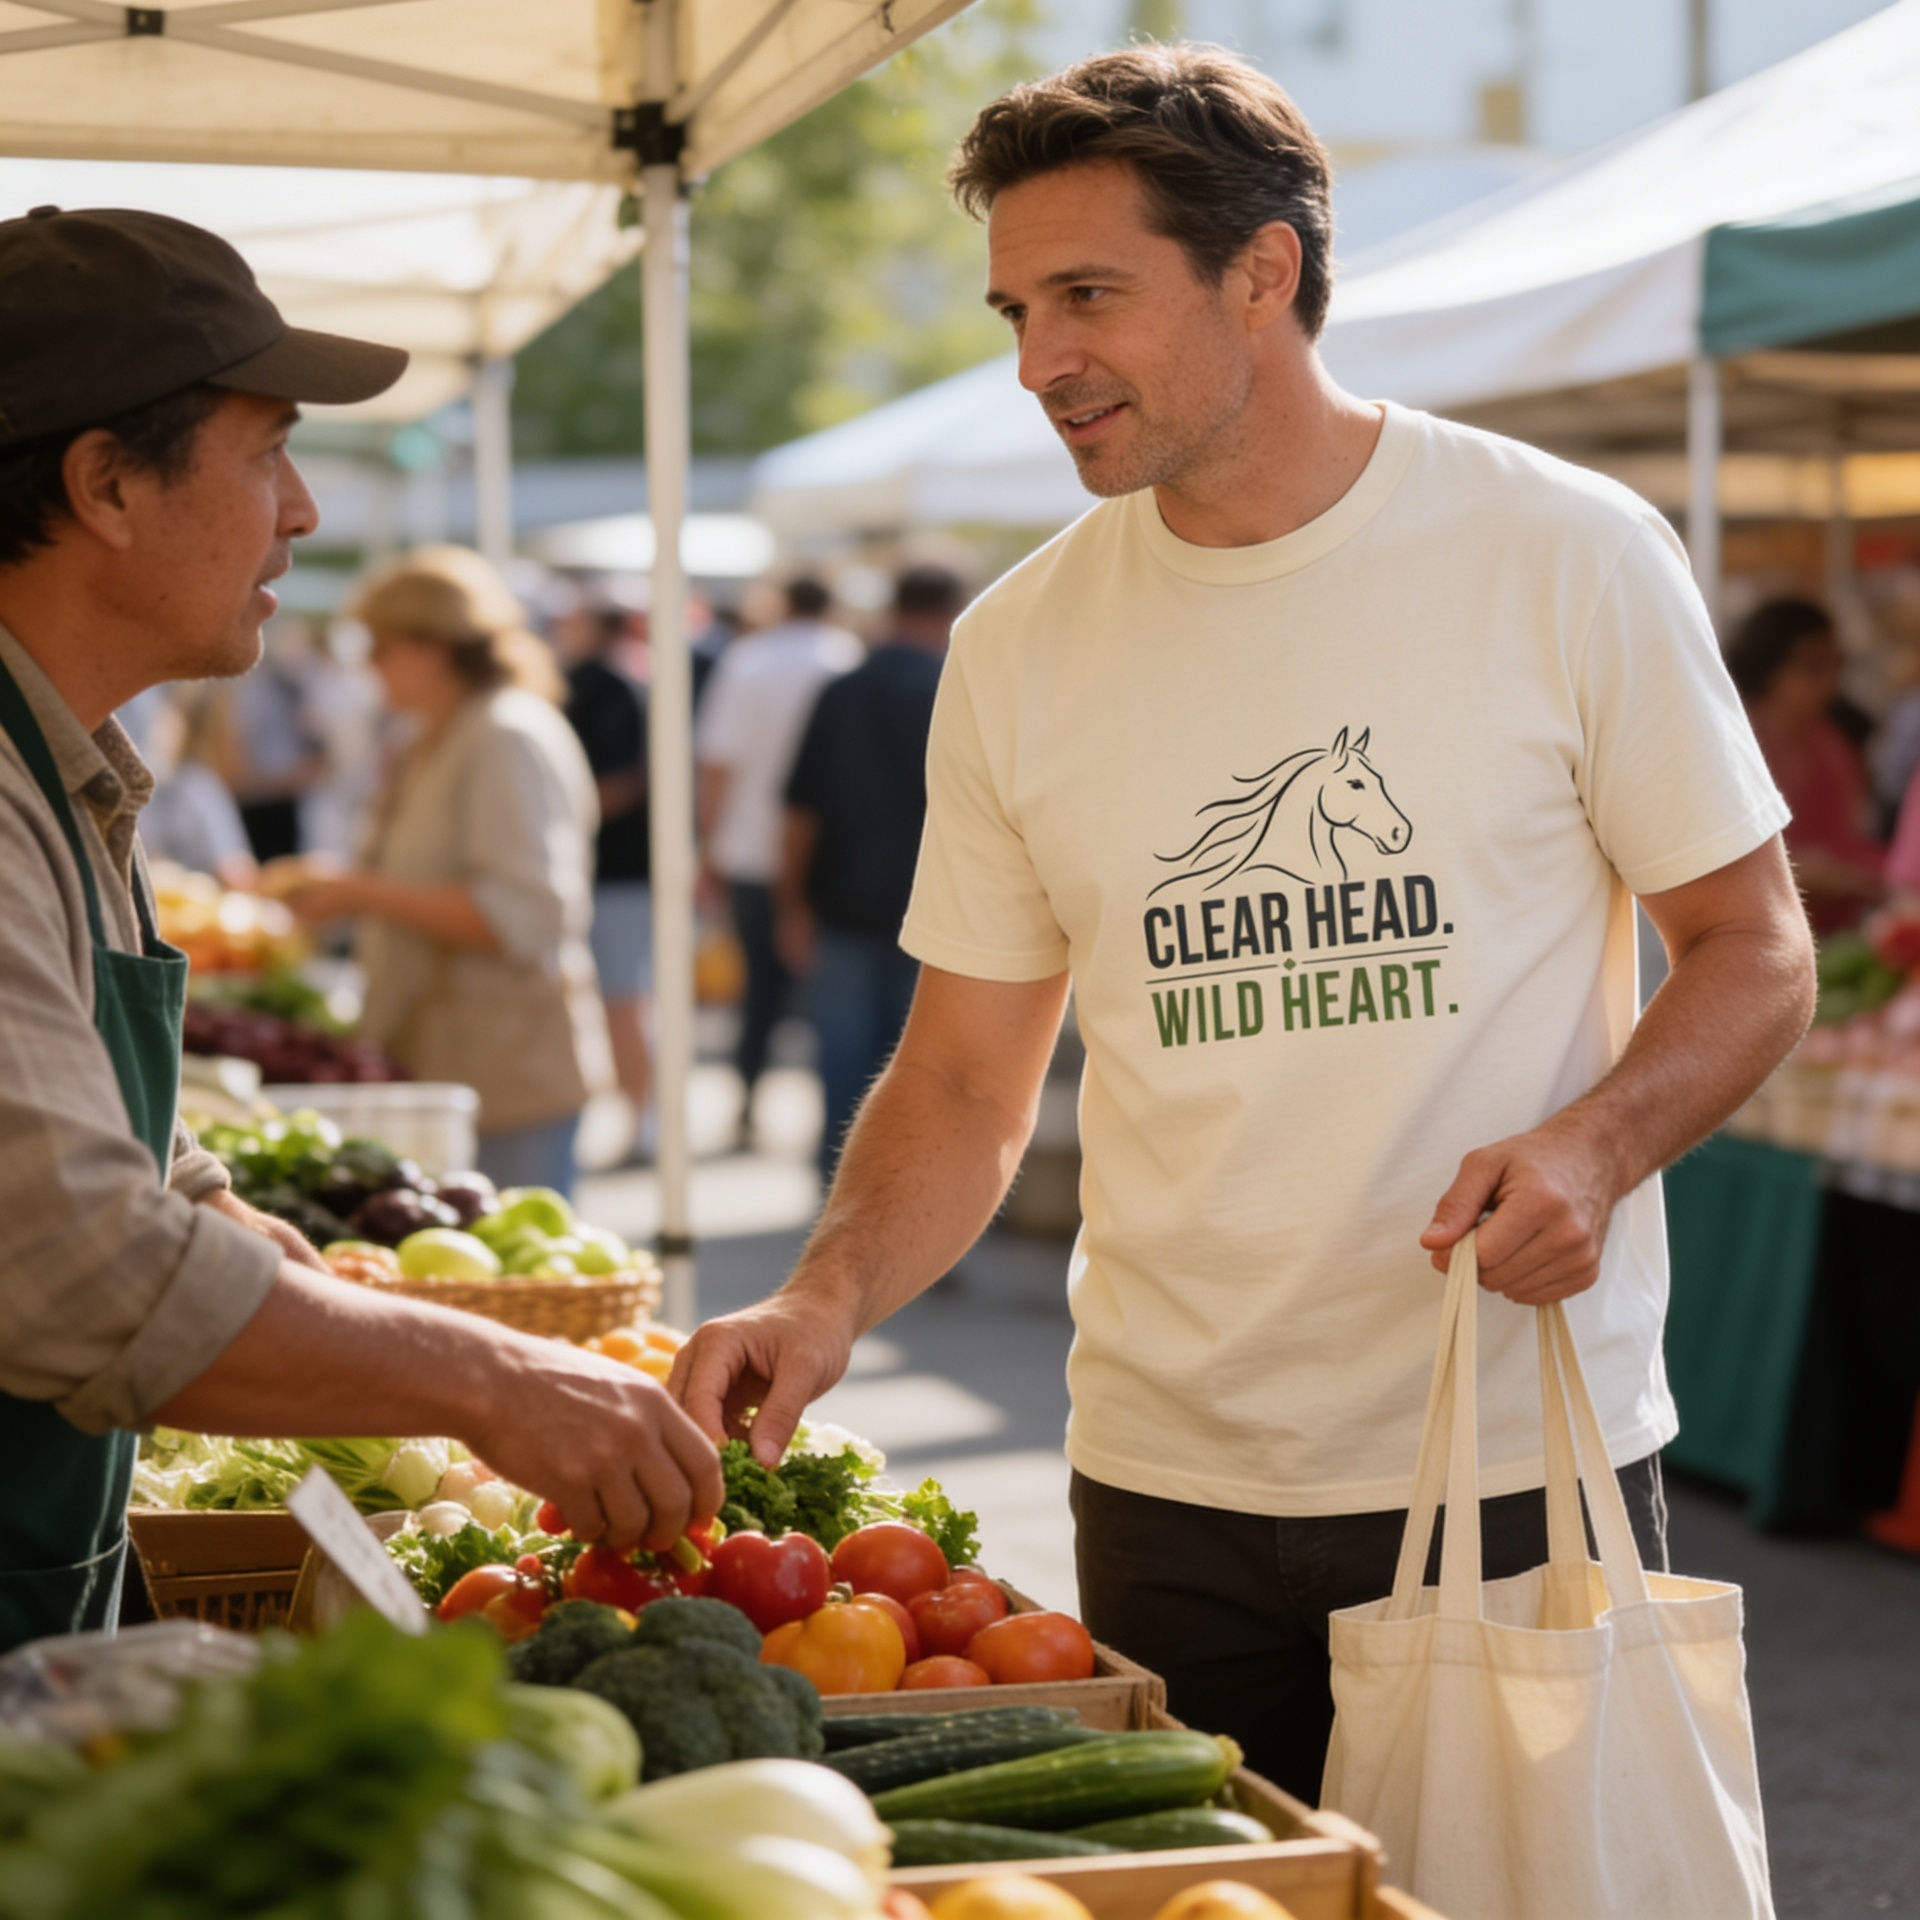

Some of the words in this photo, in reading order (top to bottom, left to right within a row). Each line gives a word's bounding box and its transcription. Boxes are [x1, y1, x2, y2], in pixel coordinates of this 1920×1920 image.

[1143, 892, 1292, 969] CLEAR
[1305, 874, 1454, 949] HEAD.
[1151, 980, 1264, 1048] WILD
[1281, 959, 1459, 1031] HEART.
